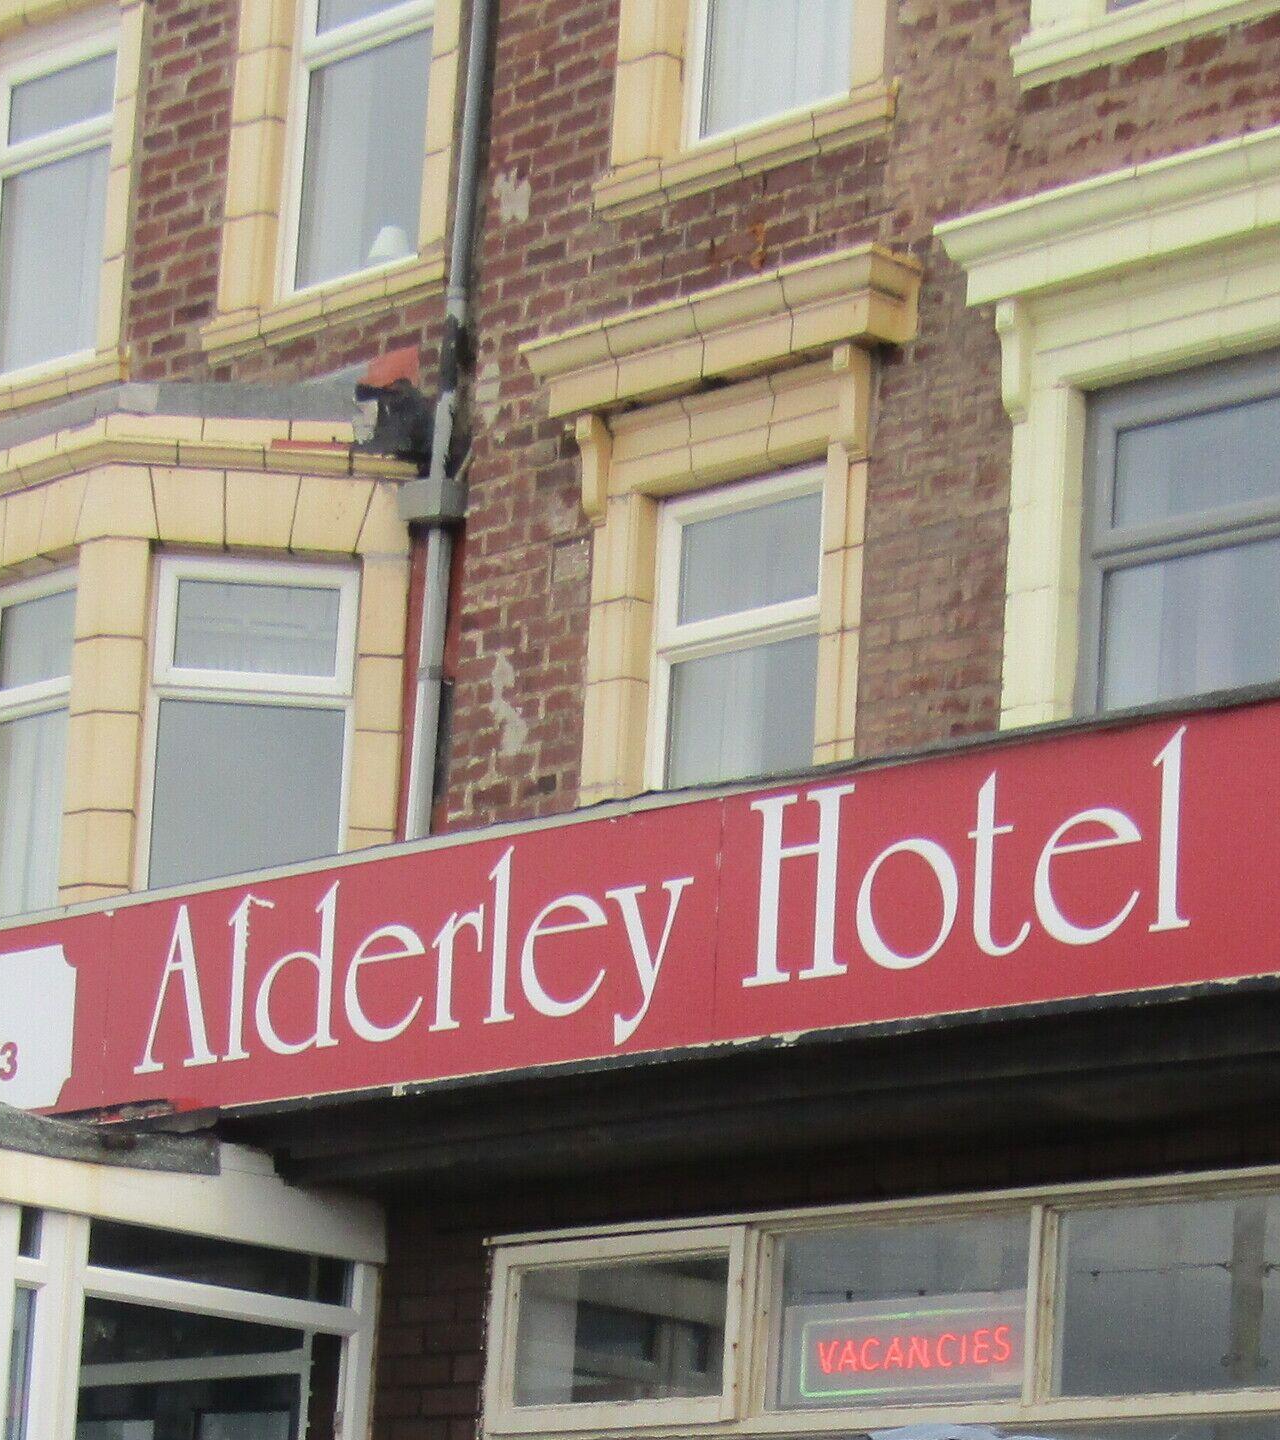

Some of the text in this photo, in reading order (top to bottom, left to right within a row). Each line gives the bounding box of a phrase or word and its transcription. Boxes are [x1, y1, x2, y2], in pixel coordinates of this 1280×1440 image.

[133, 724, 1191, 1075] Alderley Hotel
[817, 1324, 1012, 1375] VACANCIES
